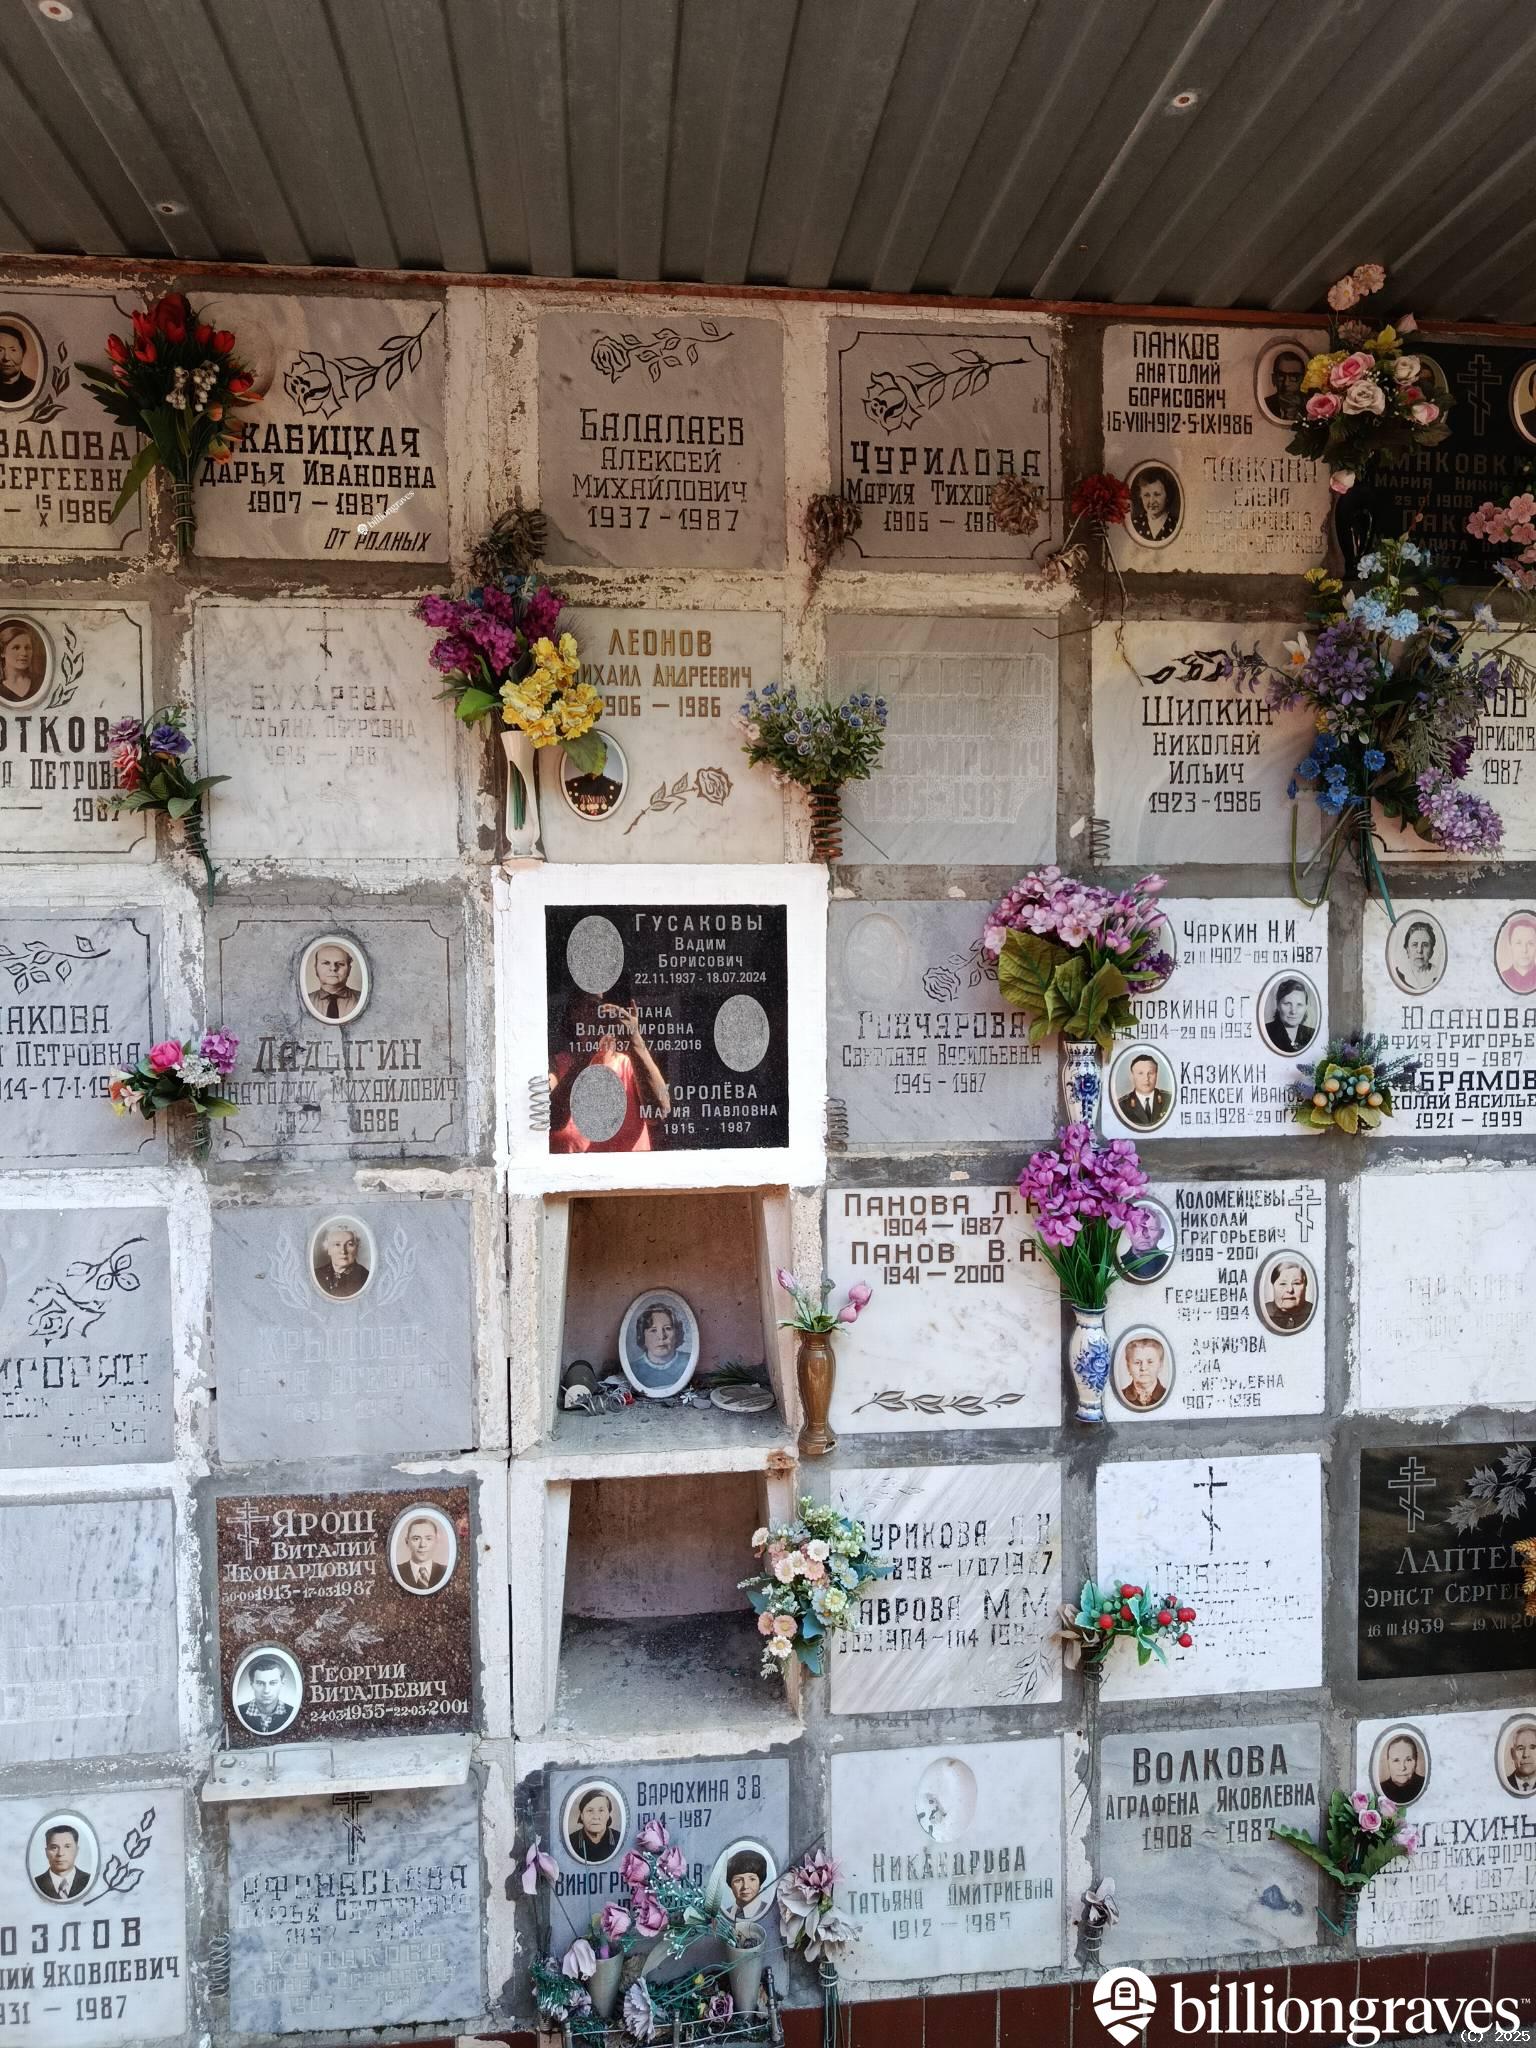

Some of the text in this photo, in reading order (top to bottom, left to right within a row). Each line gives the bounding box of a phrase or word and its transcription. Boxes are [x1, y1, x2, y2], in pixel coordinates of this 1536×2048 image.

[1133, 331, 1220, 361] ПАНКОВ
[1136, 362, 1221, 385] АНАТОЛИЙ
[1128, 387, 1226, 410] БОРИСОВИЧ
[580, 408, 743, 446] БАЛАЛАЕВ
[229, 423, 420, 460] КАБИЦКАЯ
[601, 446, 721, 473] АЛЕКСЕЙ
[850, 441, 1041, 476] ЧУРИЛОВА
[0, 464, 131, 491] ЕРГЕЕВН
[200, 457, 436, 489] ДАРЬЯ ИВАНОВНА
[572, 473, 747, 503] МИХАЙЛОВИЧ
[847, 478, 915, 505] МАРИЯ
[59, 499, 112, 523] 1986
[248, 491, 389, 516] 1907 1987
[884, 511, 996, 532] 1905 198
[354, 530, 431, 552] РОДНЫХ
[608, 628, 712, 657] ЛЕОНОВ
[652, 664, 752, 688] АНДРЕЕВИЧ
[679, 696, 721, 717] 1986
[1142, 696, 1273, 726] ШИПКИН
[0, 716, 122, 753] ТКОВ
[1153, 730, 1261, 756] НИКОЛАЙ
[1169, 761, 1244, 784] ИЛЬИЧ
[1482, 759, 1522, 784] 1987
[635, 914, 763, 932] ГУСАКОВЫ
[1184, 920, 1257, 943] ЧАРКИН
[675, 937, 726, 952] ВАДИМ
[658, 954, 743, 968] БОРИСОВИЧ
[634, 971, 767, 985] 22.11.1937 18.07.2024
[0, 1005, 109, 1034] АКОВА
[597, 1004, 673, 1019] СВЕТЛАНА
[575, 1022, 694, 1038] ВЛАДИМИРОВНА
[16, 1041, 141, 1067] ПЕТРОВНА
[645, 1040, 702, 1052] 7.06.2016
[938, 1044, 1042, 1066] ВАСИЛЬЕВНА
[1482, 1052, 1523, 1067] 1987
[1181, 1062, 1266, 1084] КАЗИКИН
[640, 1104, 777, 1119] МАРИЯ ПАВЛОВНА
[1391, 1092, 1450, 1110] КОЛАЙ
[355, 1109, 399, 1133] 1986
[664, 1122, 751, 1134] 1915 1987
[1416, 1111, 1522, 1129] 1921 1999
[844, 1194, 969, 1217] ПАНОВА
[884, 1217, 1004, 1236] 1904 1987
[1181, 1210, 1248, 1228] НИКОЛАЙ
[1181, 1228, 1286, 1245] ГРИГОРЬЕВИЧ
[851, 1241, 955, 1264] ПАНОВ
[884, 1265, 1004, 1284] 1941 2000
[1218, 1267, 1248, 1285] ИДА
[271, 1509, 376, 1538] ЯРОШ
[271, 1534, 376, 1560] ВИТАЛИЙ
[223, 1560, 376, 1583] ЛЕОНАРДОВИЧ
[1364, 1587, 1434, 1608] ЭРНСТ
[860, 1594, 960, 1626] АВРОВА
[1402, 1617, 1444, 1636] 1939
[311, 1661, 406, 1684] ГЕОРГИЙ
[311, 1681, 447, 1704] ВИТАЛЬЕВИЧ
[1133, 1744, 1288, 1786] ВОЛКОВА
[638, 1779, 729, 1806] ВАРЮХИНА
[1106, 1783, 1316, 1821] АГРАФЕНА ЯКОВЛЕВНА
[1143, 1817, 1276, 1851] 1908 1987
[848, 1878, 1053, 1915] ТАТЬЯНА ДМИТРИЕВНА
[893, 1919, 932, 1940] 1912
[43, 1956, 180, 1988] ЯКОВЛЕВИЧ
[76, 1995, 127, 2021] 1987
